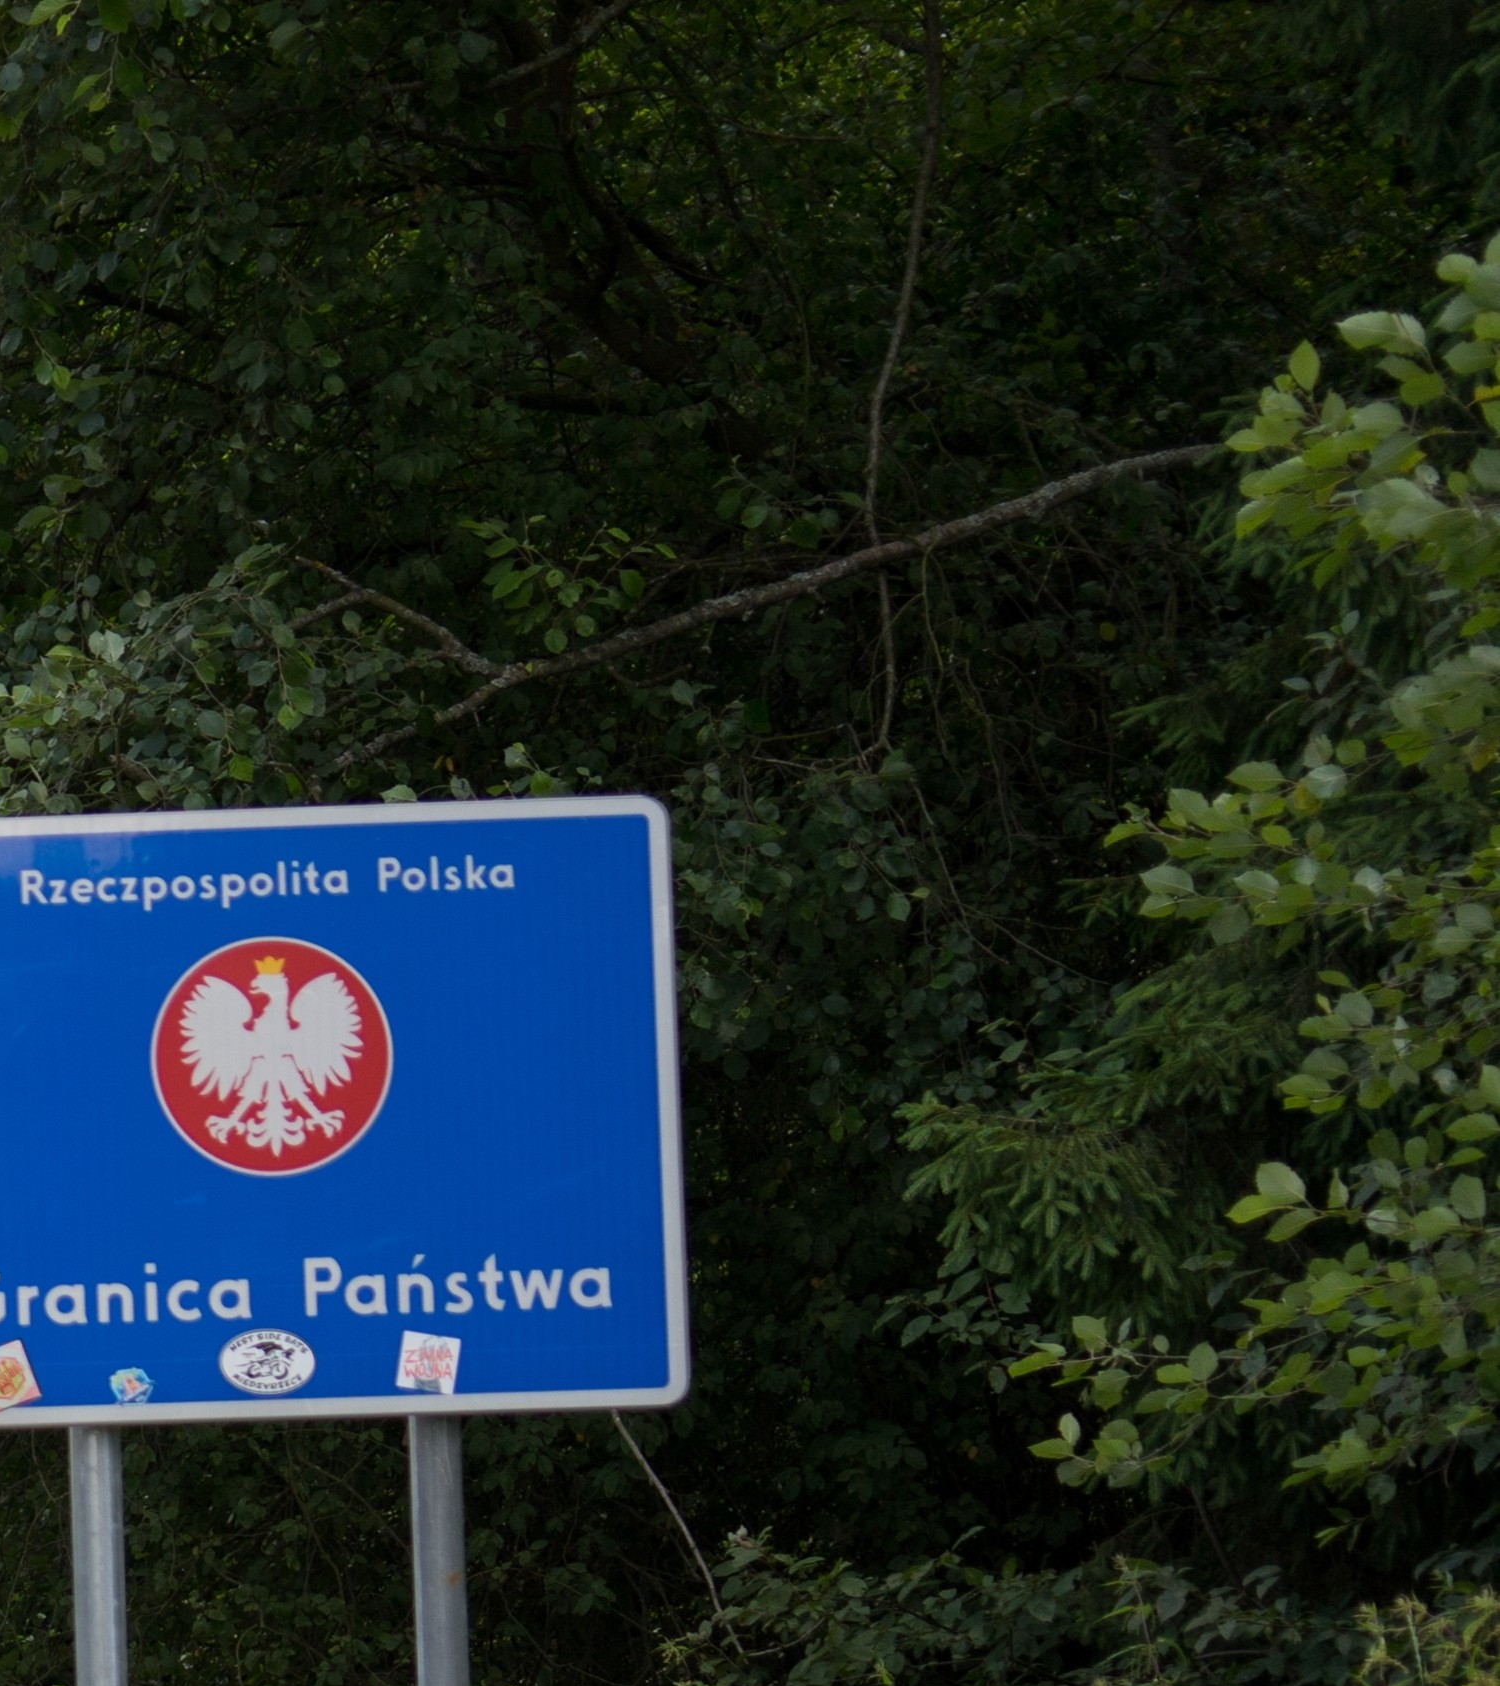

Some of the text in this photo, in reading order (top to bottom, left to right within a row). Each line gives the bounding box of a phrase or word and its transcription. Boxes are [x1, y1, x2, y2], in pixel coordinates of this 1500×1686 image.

[19, 855, 516, 912] Rzeczpospolita Polska
[304, 1254, 613, 1317] Państwa
